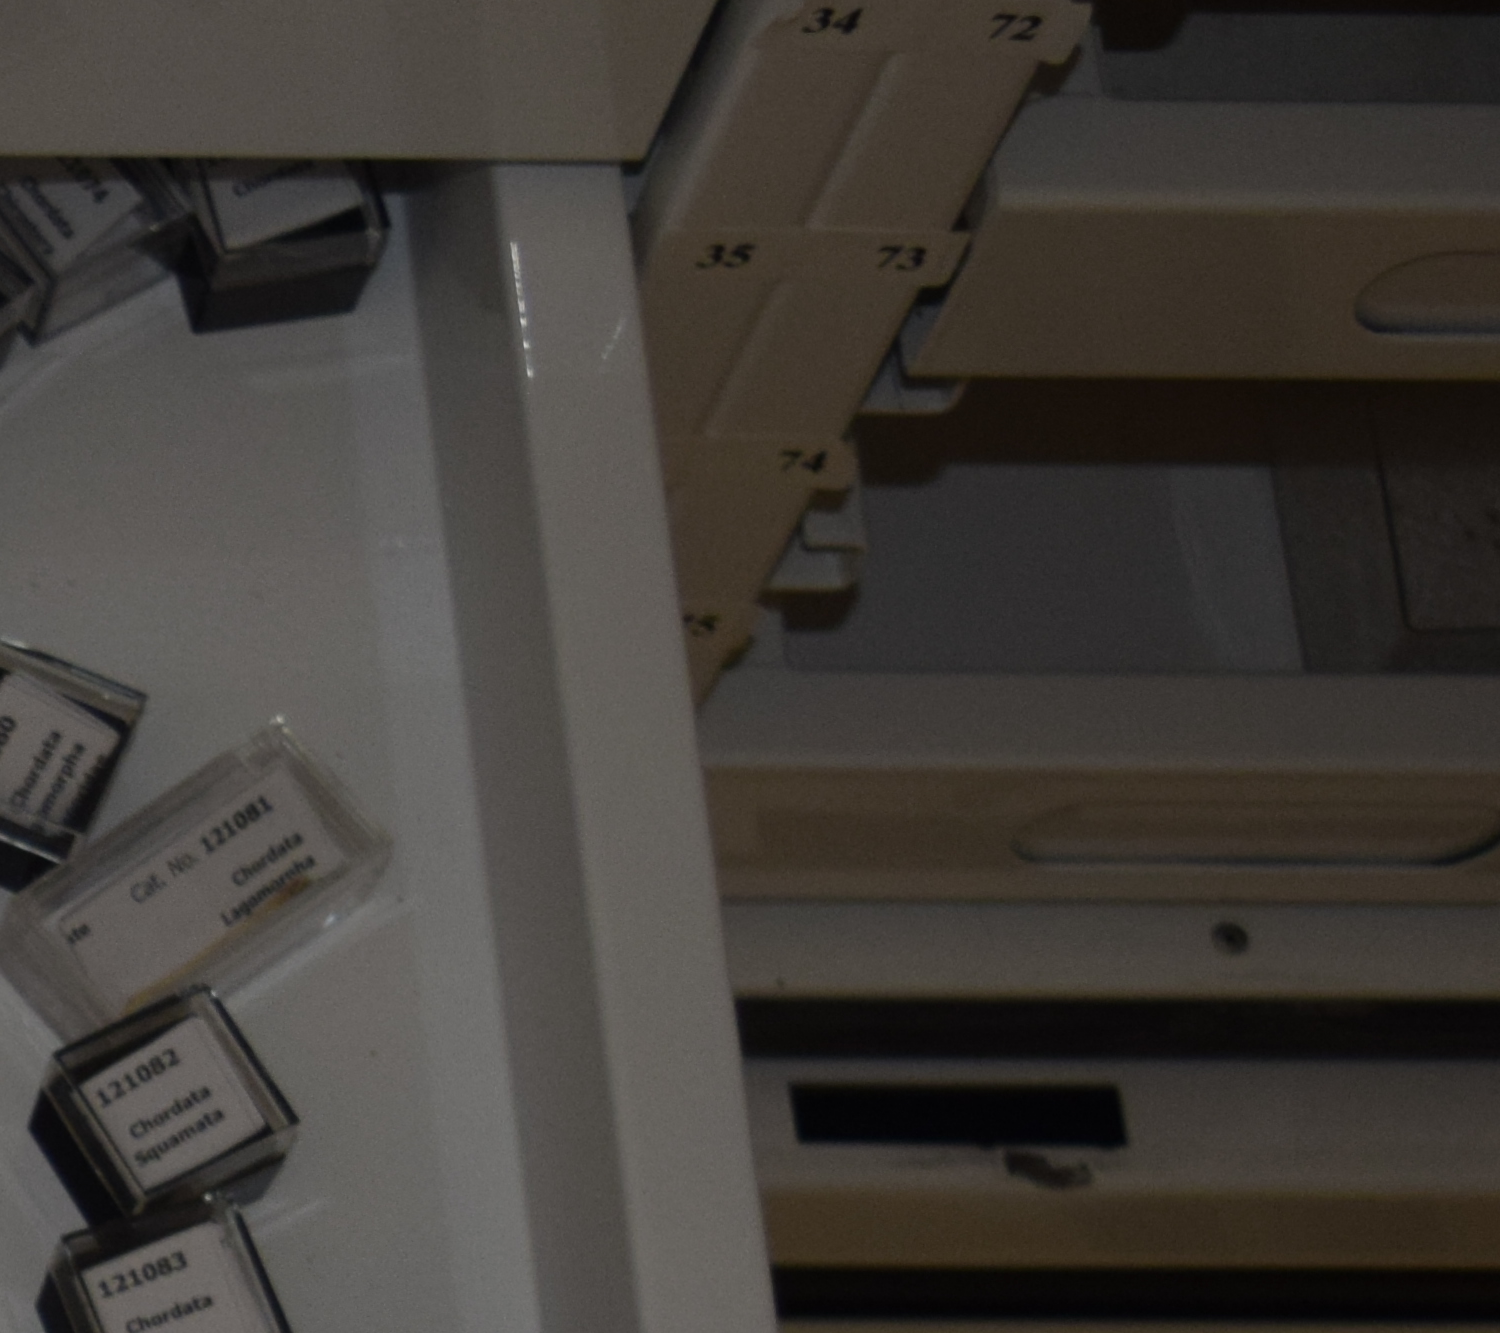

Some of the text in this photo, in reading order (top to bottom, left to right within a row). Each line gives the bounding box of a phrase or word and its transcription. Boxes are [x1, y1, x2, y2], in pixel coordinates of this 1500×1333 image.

[802, 6, 864, 35] 34
[989, 14, 1042, 40] 72
[696, 244, 755, 267] 35
[878, 247, 925, 270] 73
[780, 451, 828, 472] 74
[201, 796, 273, 853] 121081
[97, 1049, 180, 1108] 121082
[99, 1251, 187, 1298] 121083
